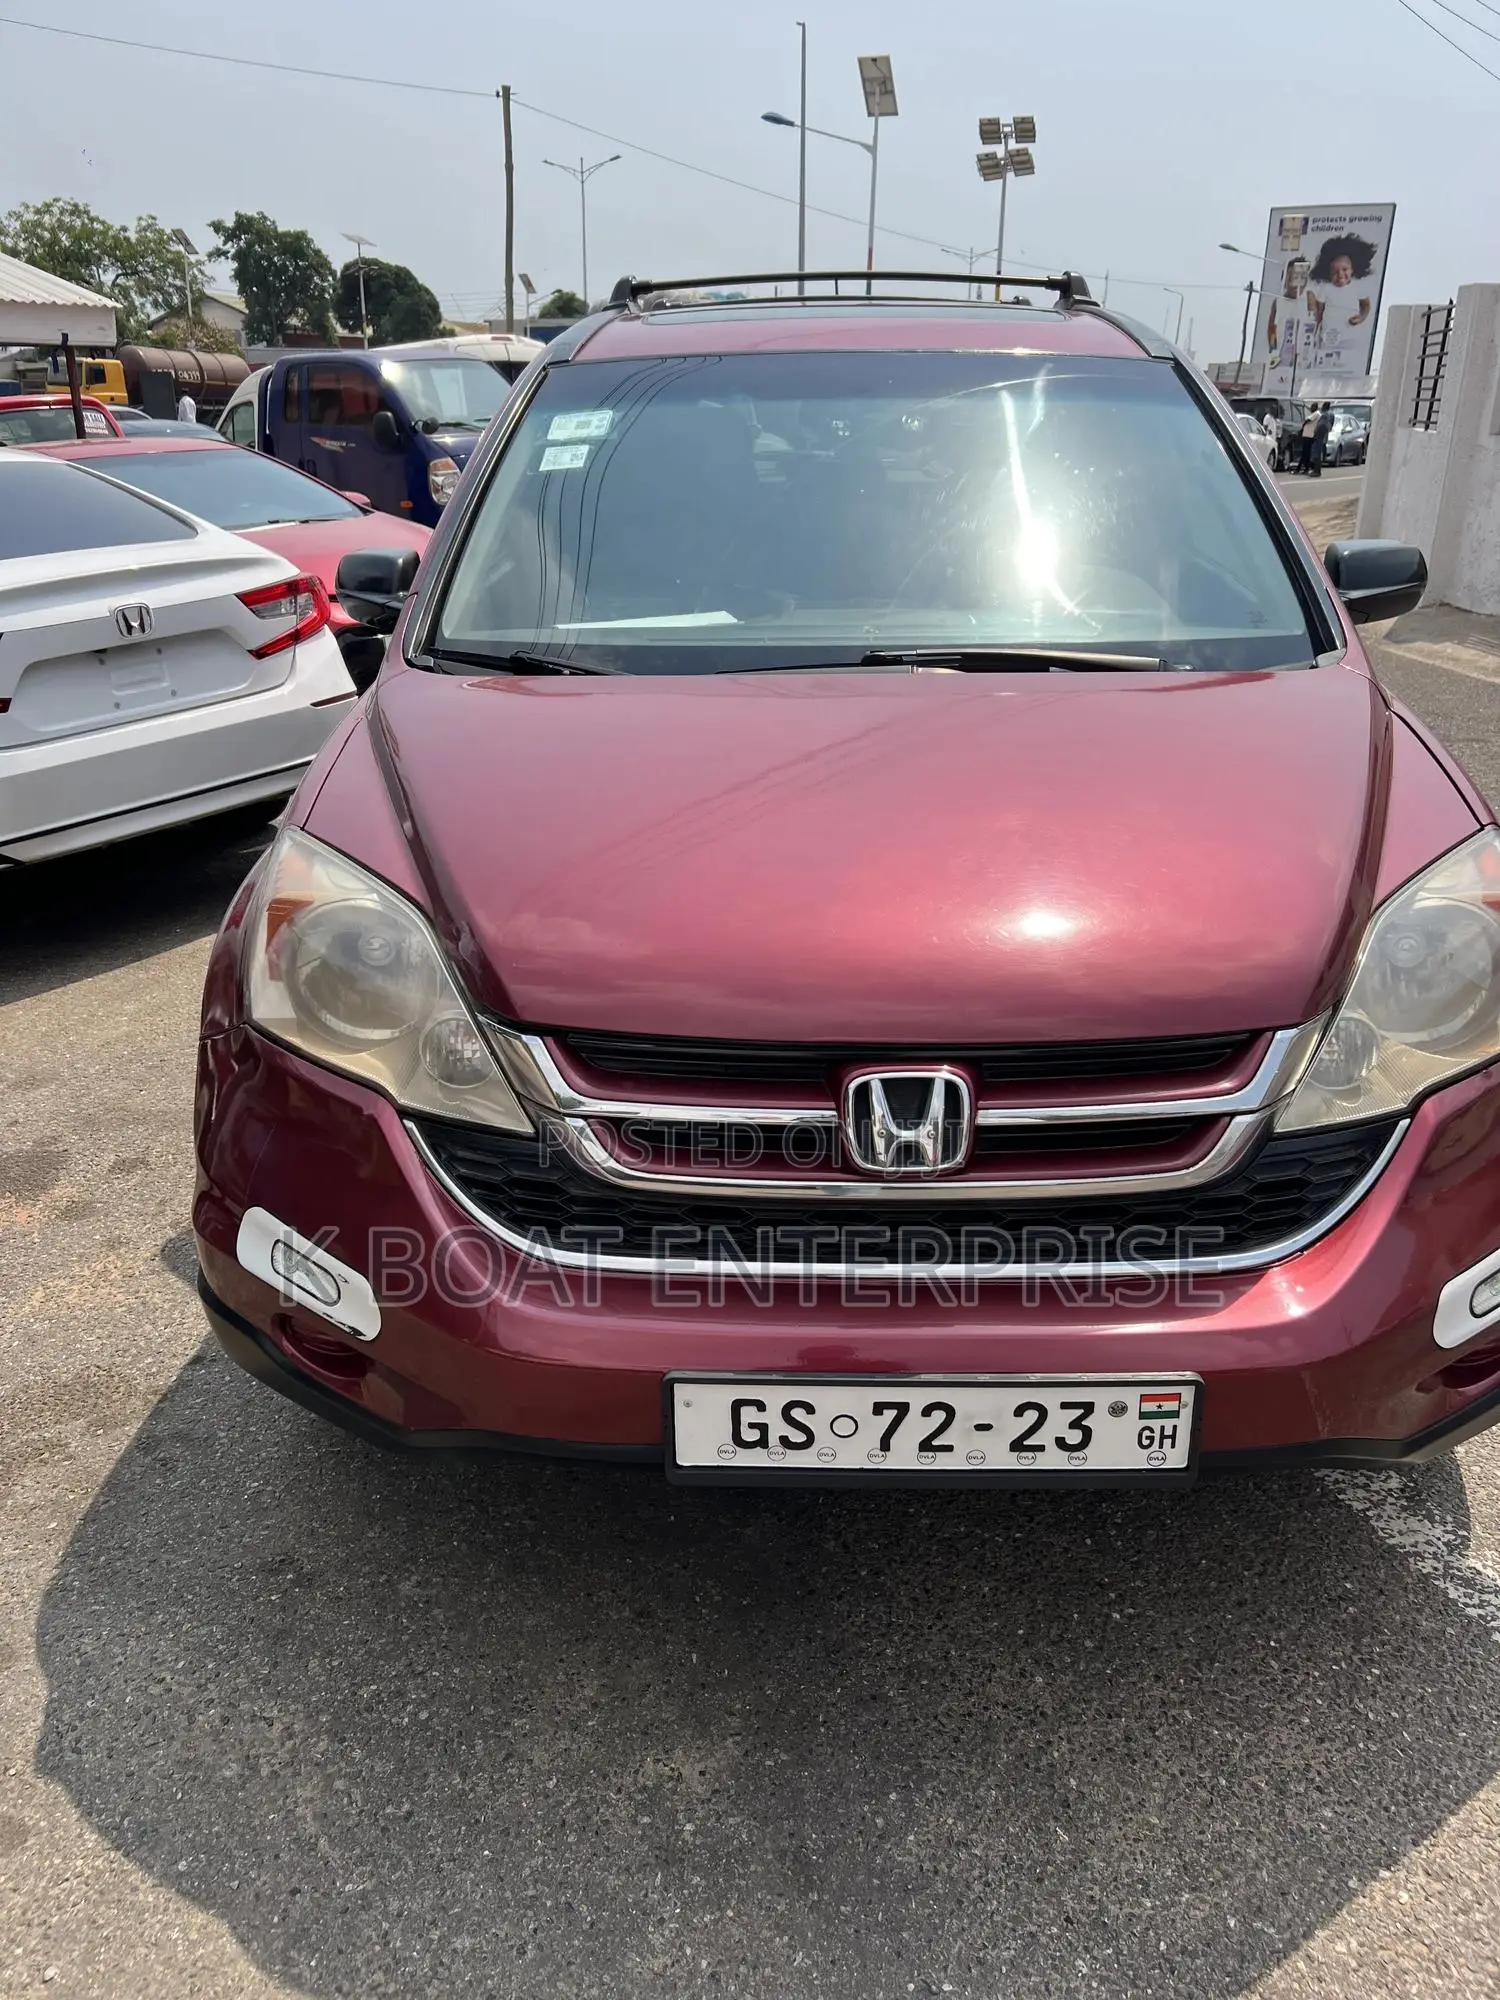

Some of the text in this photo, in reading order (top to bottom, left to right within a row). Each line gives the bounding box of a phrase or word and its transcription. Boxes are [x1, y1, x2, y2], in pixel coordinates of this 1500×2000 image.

[1311, 224, 1344, 232] children
[1312, 214, 1383, 224] protects growing
[730, 1398, 816, 1451] GS
[1137, 1424, 1177, 1450] GH
